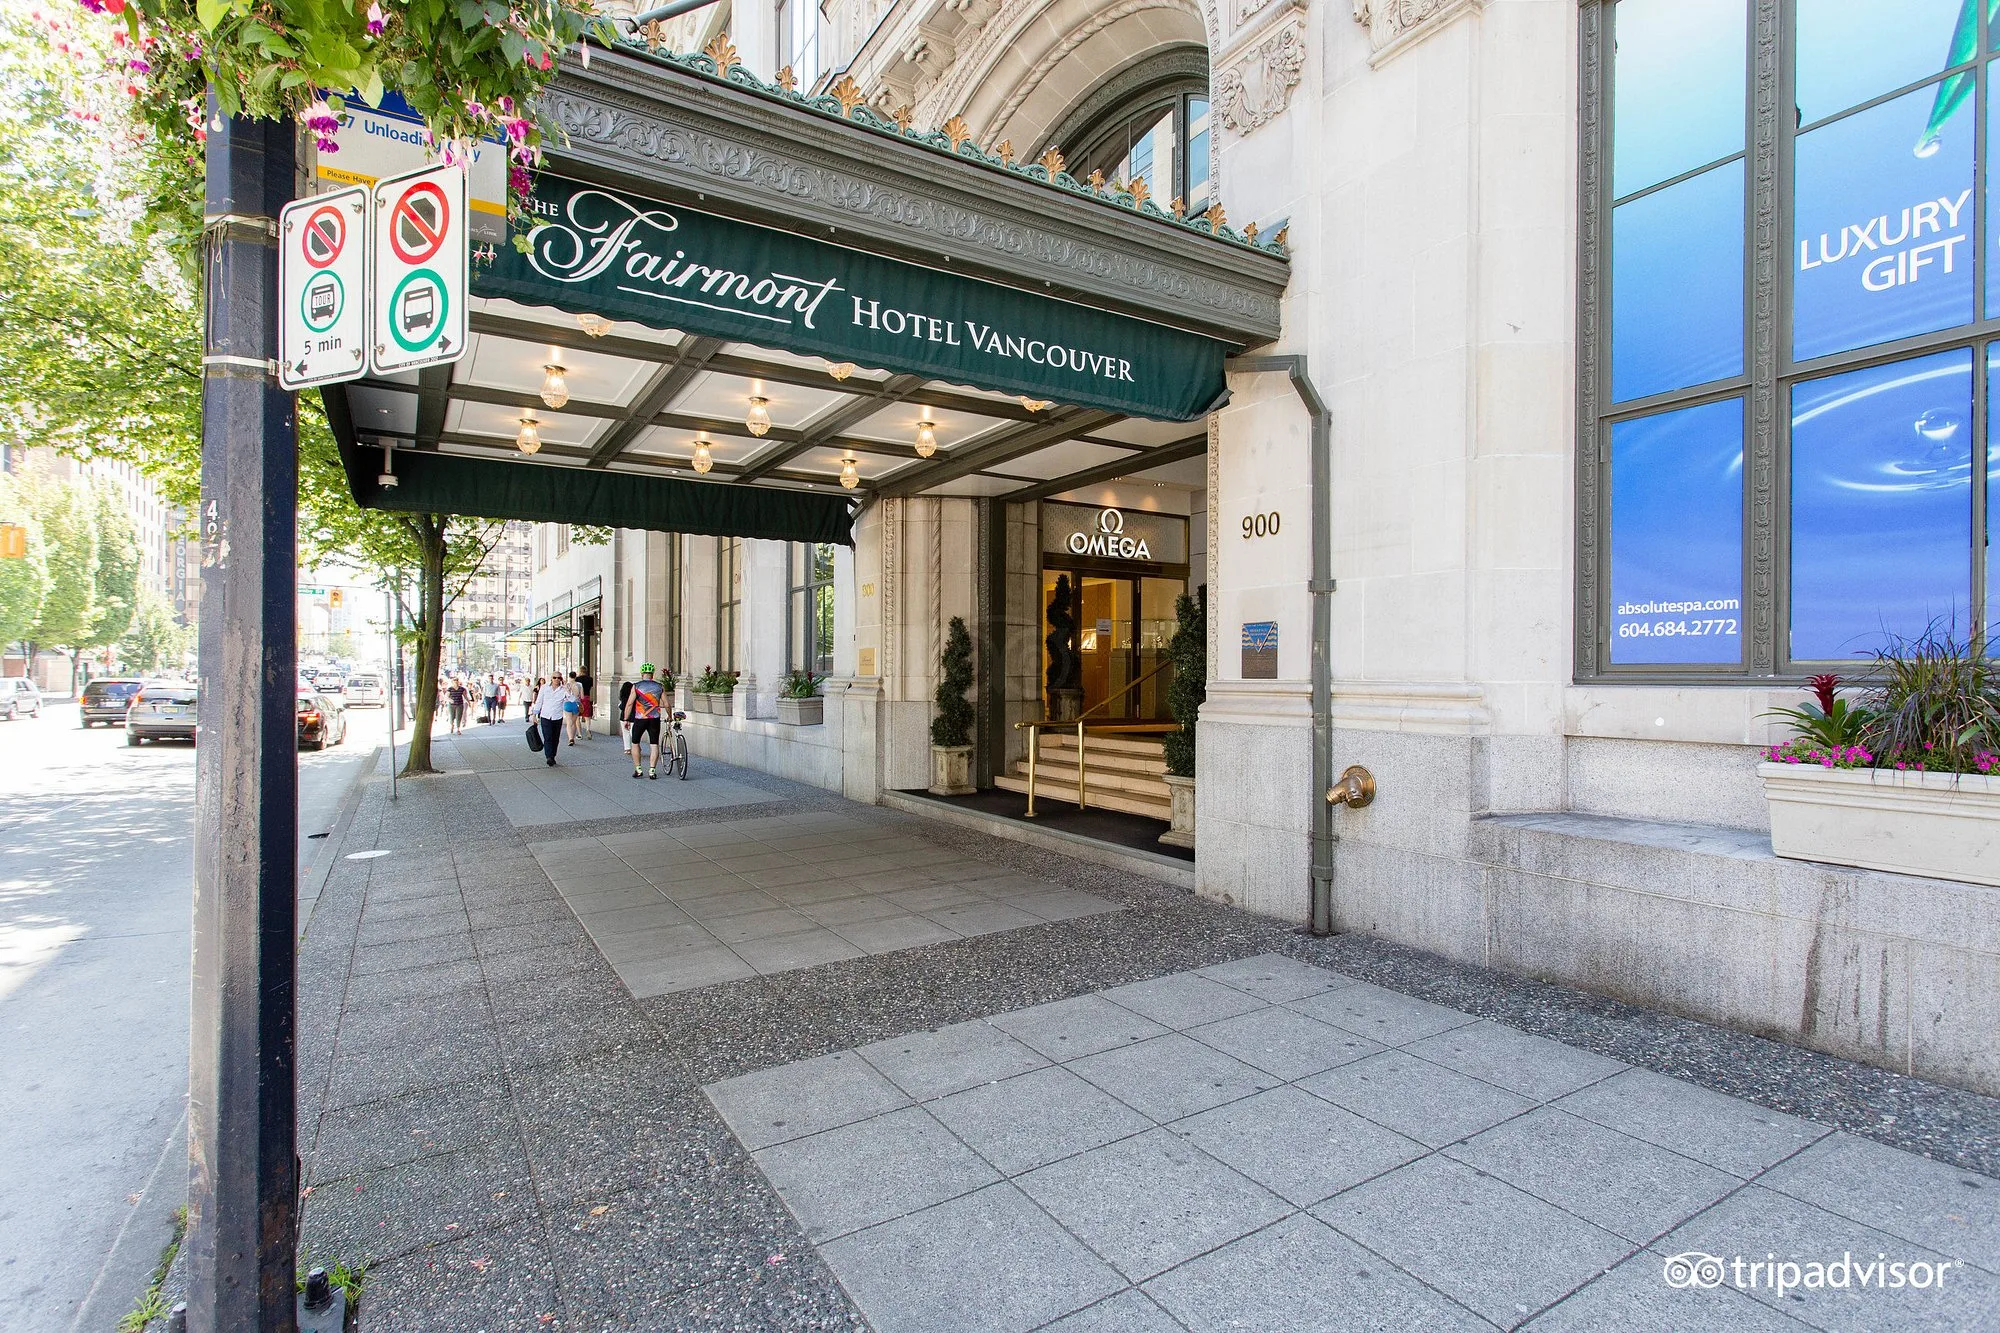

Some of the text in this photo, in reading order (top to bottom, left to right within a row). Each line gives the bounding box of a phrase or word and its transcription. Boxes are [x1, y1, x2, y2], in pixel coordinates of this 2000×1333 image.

[364, 119, 442, 154] Unloadi
[326, 169, 351, 182] Please
[352, 175, 372, 187] Have
[1800, 188, 1972, 271] LUXURY
[1861, 234, 1966, 292] GIFT
[315, 294, 332, 306] TOUR
[524, 190, 846, 330] Fairmont
[852, 295, 961, 347] HOTEL
[965, 320, 1135, 383] VANCOUVER
[304, 335, 342, 355] 5 min
[1242, 511, 1281, 539] 900
[1068, 532, 1152, 560] OMEGA
[175, 522, 186, 601] EORGIA
[1618, 599, 1739, 615] absolutespa.com
[1619, 619, 1737, 637] 604.684.2772
